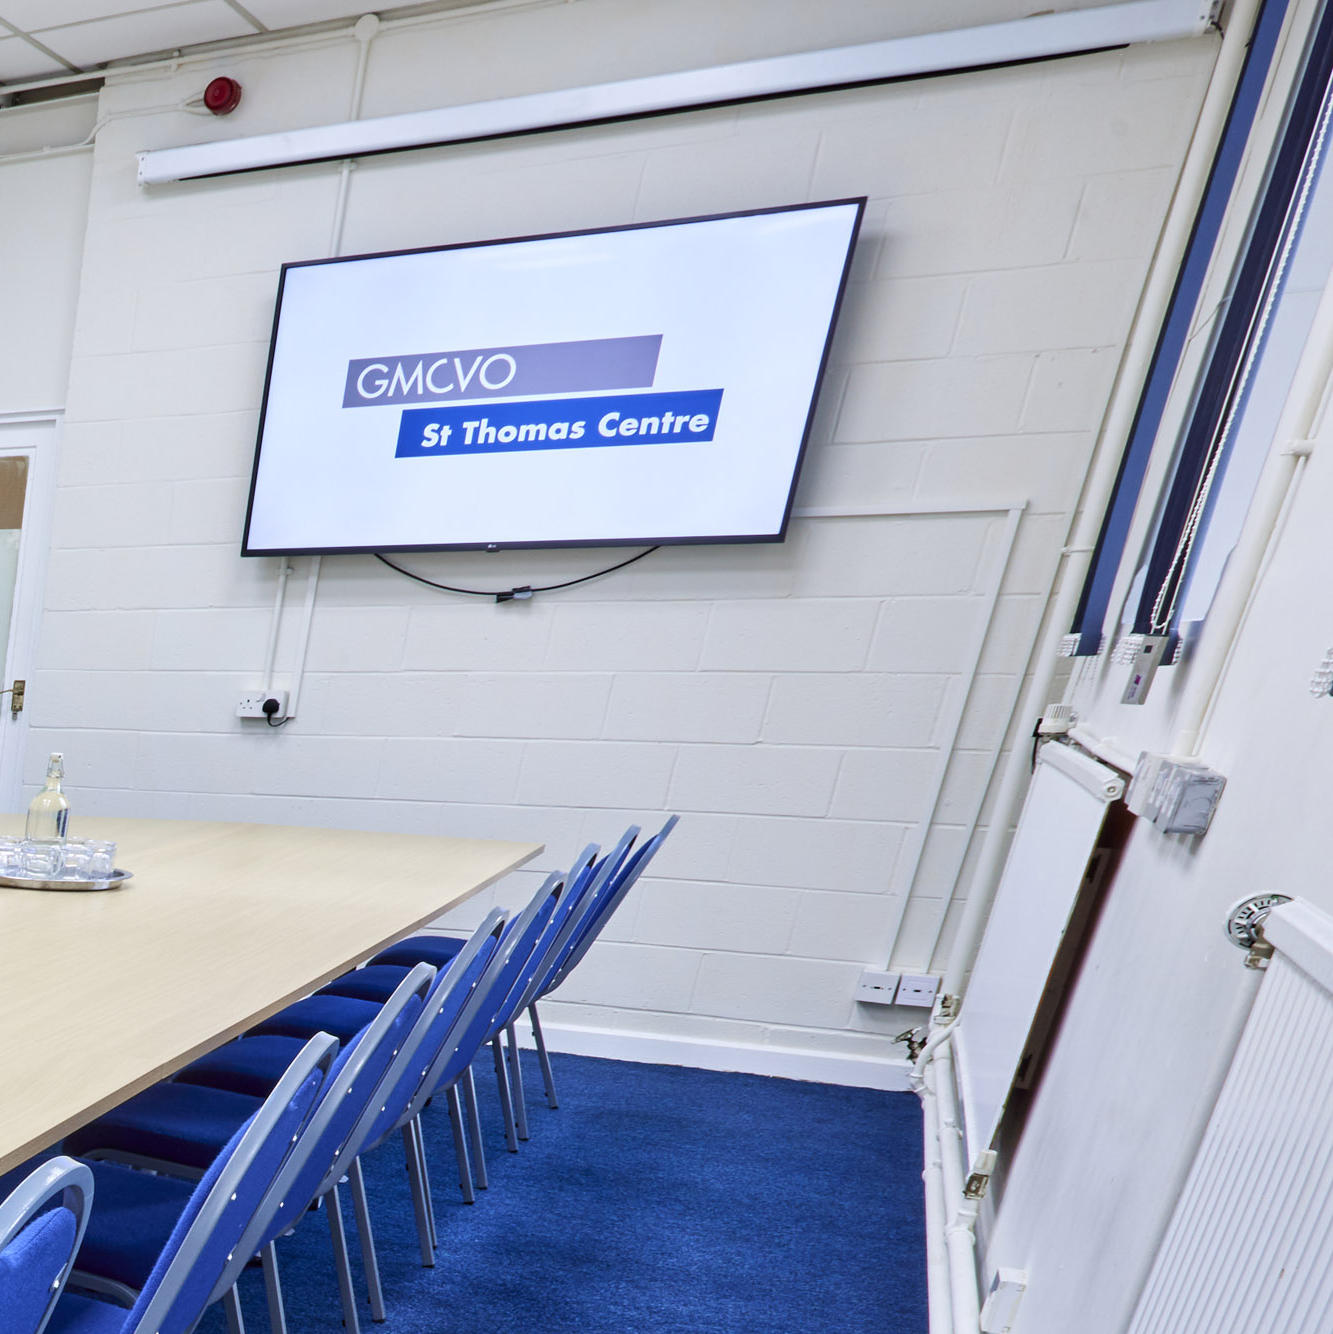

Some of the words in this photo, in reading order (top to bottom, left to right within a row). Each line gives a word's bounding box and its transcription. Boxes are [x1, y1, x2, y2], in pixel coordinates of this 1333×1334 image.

[356, 353, 517, 399] GMCVO
[420, 422, 452, 448] St
[462, 419, 586, 445] Thomas
[598, 412, 710, 438] Centre
